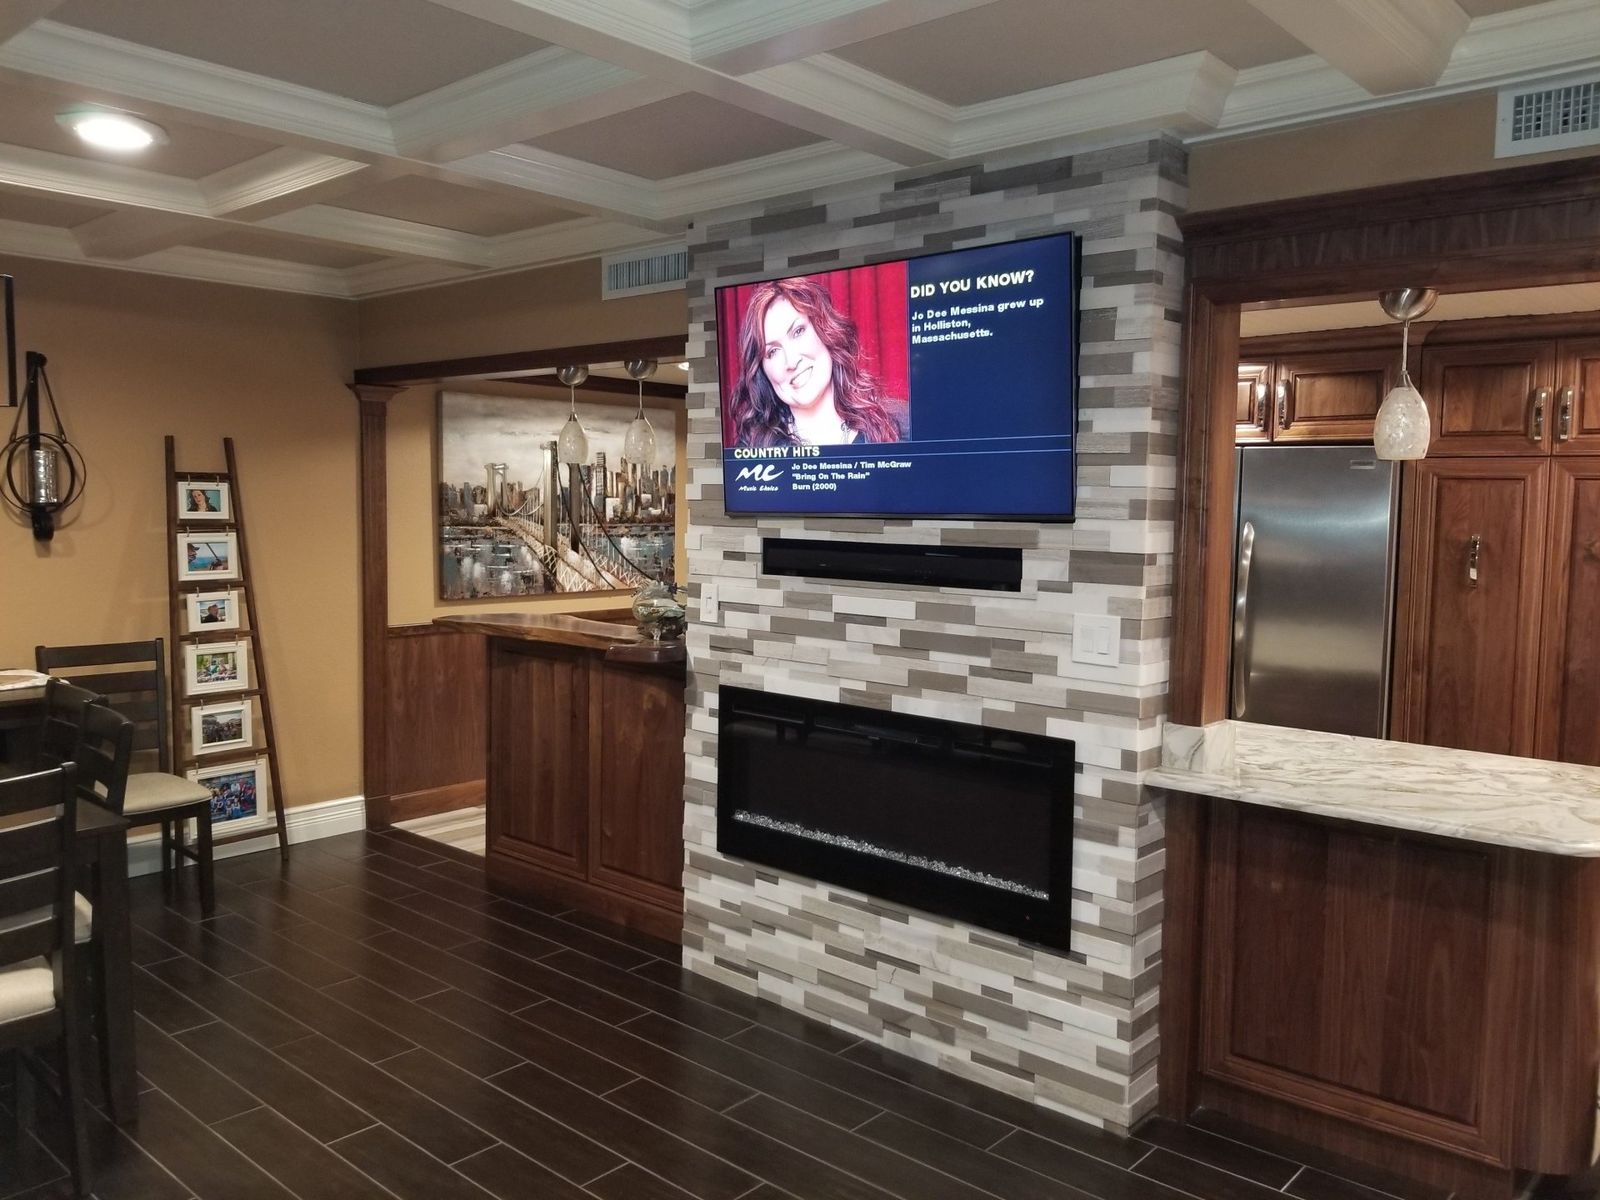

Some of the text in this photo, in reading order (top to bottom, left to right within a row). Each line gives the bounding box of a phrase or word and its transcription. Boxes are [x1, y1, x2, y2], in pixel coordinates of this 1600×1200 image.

[910, 269, 1035, 298] DID YOU KNOW?
[911, 298, 1044, 321] Jo Dee Messina grew up
[911, 319, 971, 333] in Holliston,
[911, 329, 993, 344] Massachusetts.
[734, 446, 820, 459] COUNTRY HITS
[819, 462, 852, 470] Messina
[860, 461, 875, 469] Tim
[877, 461, 912, 469] McGraw
[735, 464, 784, 482] MC
[791, 473, 816, 481] "Bring
[831, 472, 845, 480] The
[847, 472, 870, 480] Rain"
[812, 483, 837, 491] (2000)
